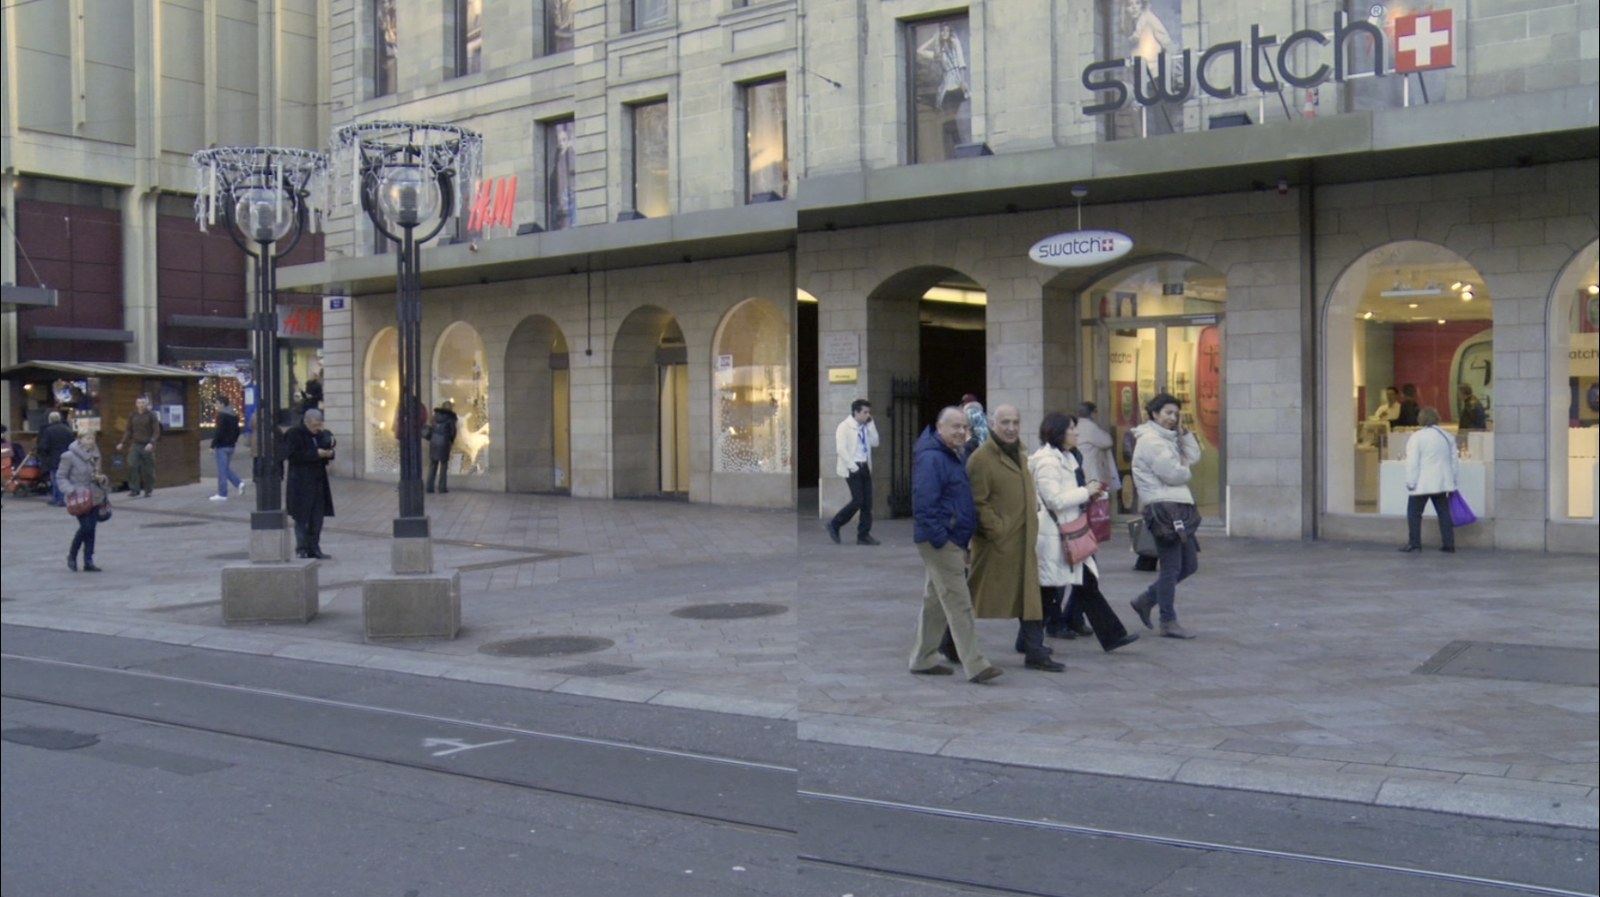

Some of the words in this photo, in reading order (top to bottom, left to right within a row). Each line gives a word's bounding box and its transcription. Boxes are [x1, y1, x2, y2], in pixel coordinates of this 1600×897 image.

[1082, 10, 1388, 117] swatch
[466, 175, 518, 233] H&M
[1039, 238, 1101, 258] swatch
